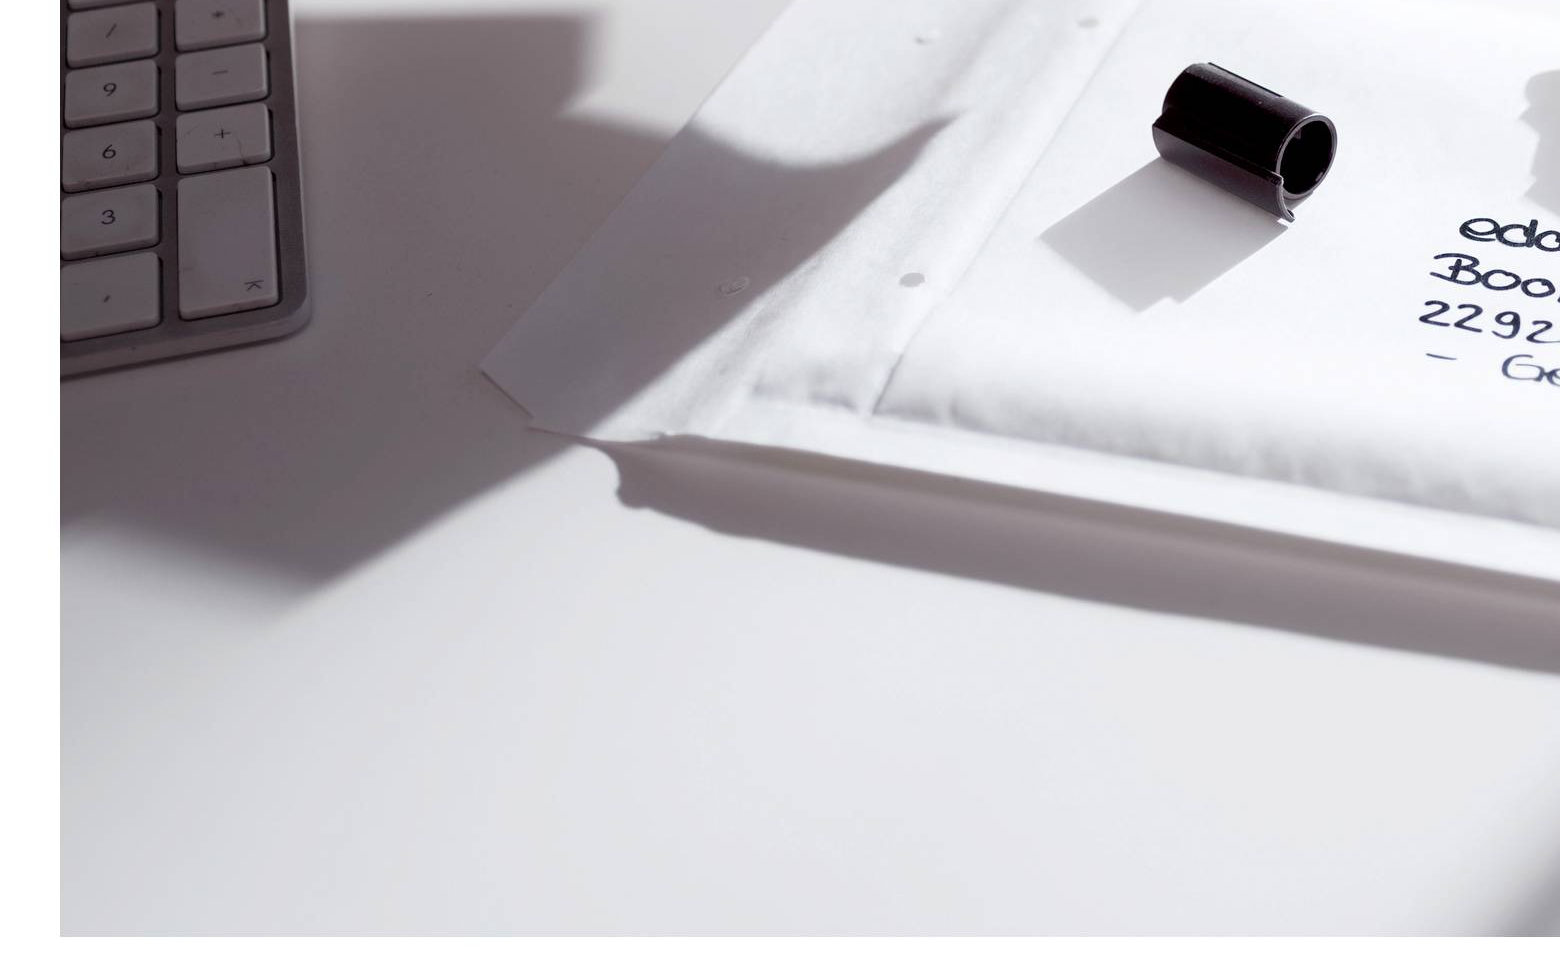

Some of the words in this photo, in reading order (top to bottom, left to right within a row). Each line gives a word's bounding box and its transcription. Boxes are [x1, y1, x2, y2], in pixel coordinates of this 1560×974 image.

[102, 81, 118, 97] 9
[101, 143, 117, 160] 6
[100, 209, 117, 226] 3
